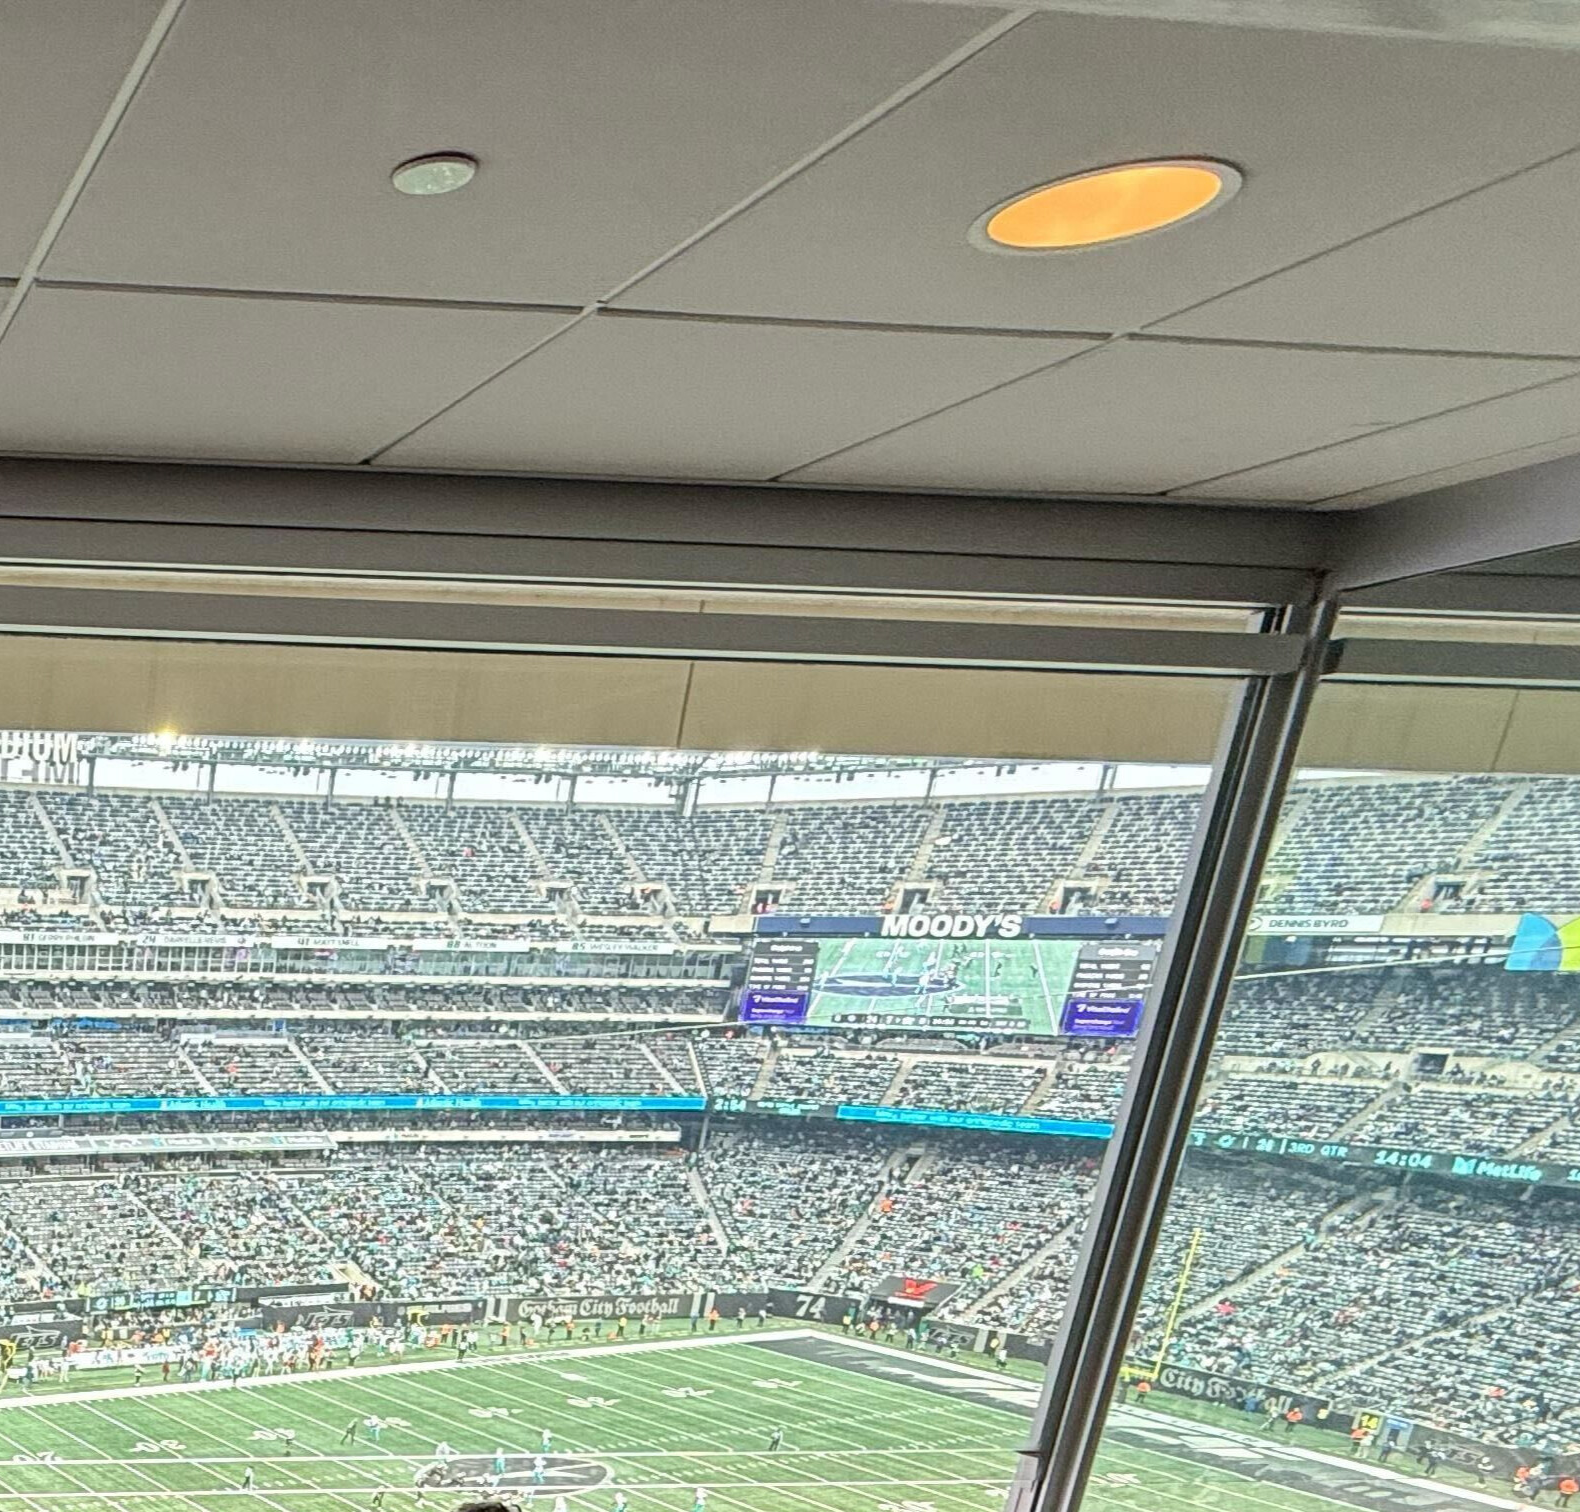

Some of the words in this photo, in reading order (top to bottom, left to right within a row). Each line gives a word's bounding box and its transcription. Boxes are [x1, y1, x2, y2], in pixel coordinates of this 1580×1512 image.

[881, 914, 1022, 938] MOODY'S
[1269, 918, 1312, 928] DENNIS
[1314, 918, 1349, 928] BYRD
[1288, 1142, 1315, 1156] 3RD
[1321, 1144, 1348, 1158] QTR
[1374, 1150, 1433, 1169] 14:04
[1477, 1161, 1543, 1182] MetLife
[518, 1299, 578, 1319] Gotham
[580, 1298, 614, 1318] City
[616, 1297, 679, 1316] Football
[795, 1295, 826, 1319] 74
[1160, 1368, 1206, 1395] City
